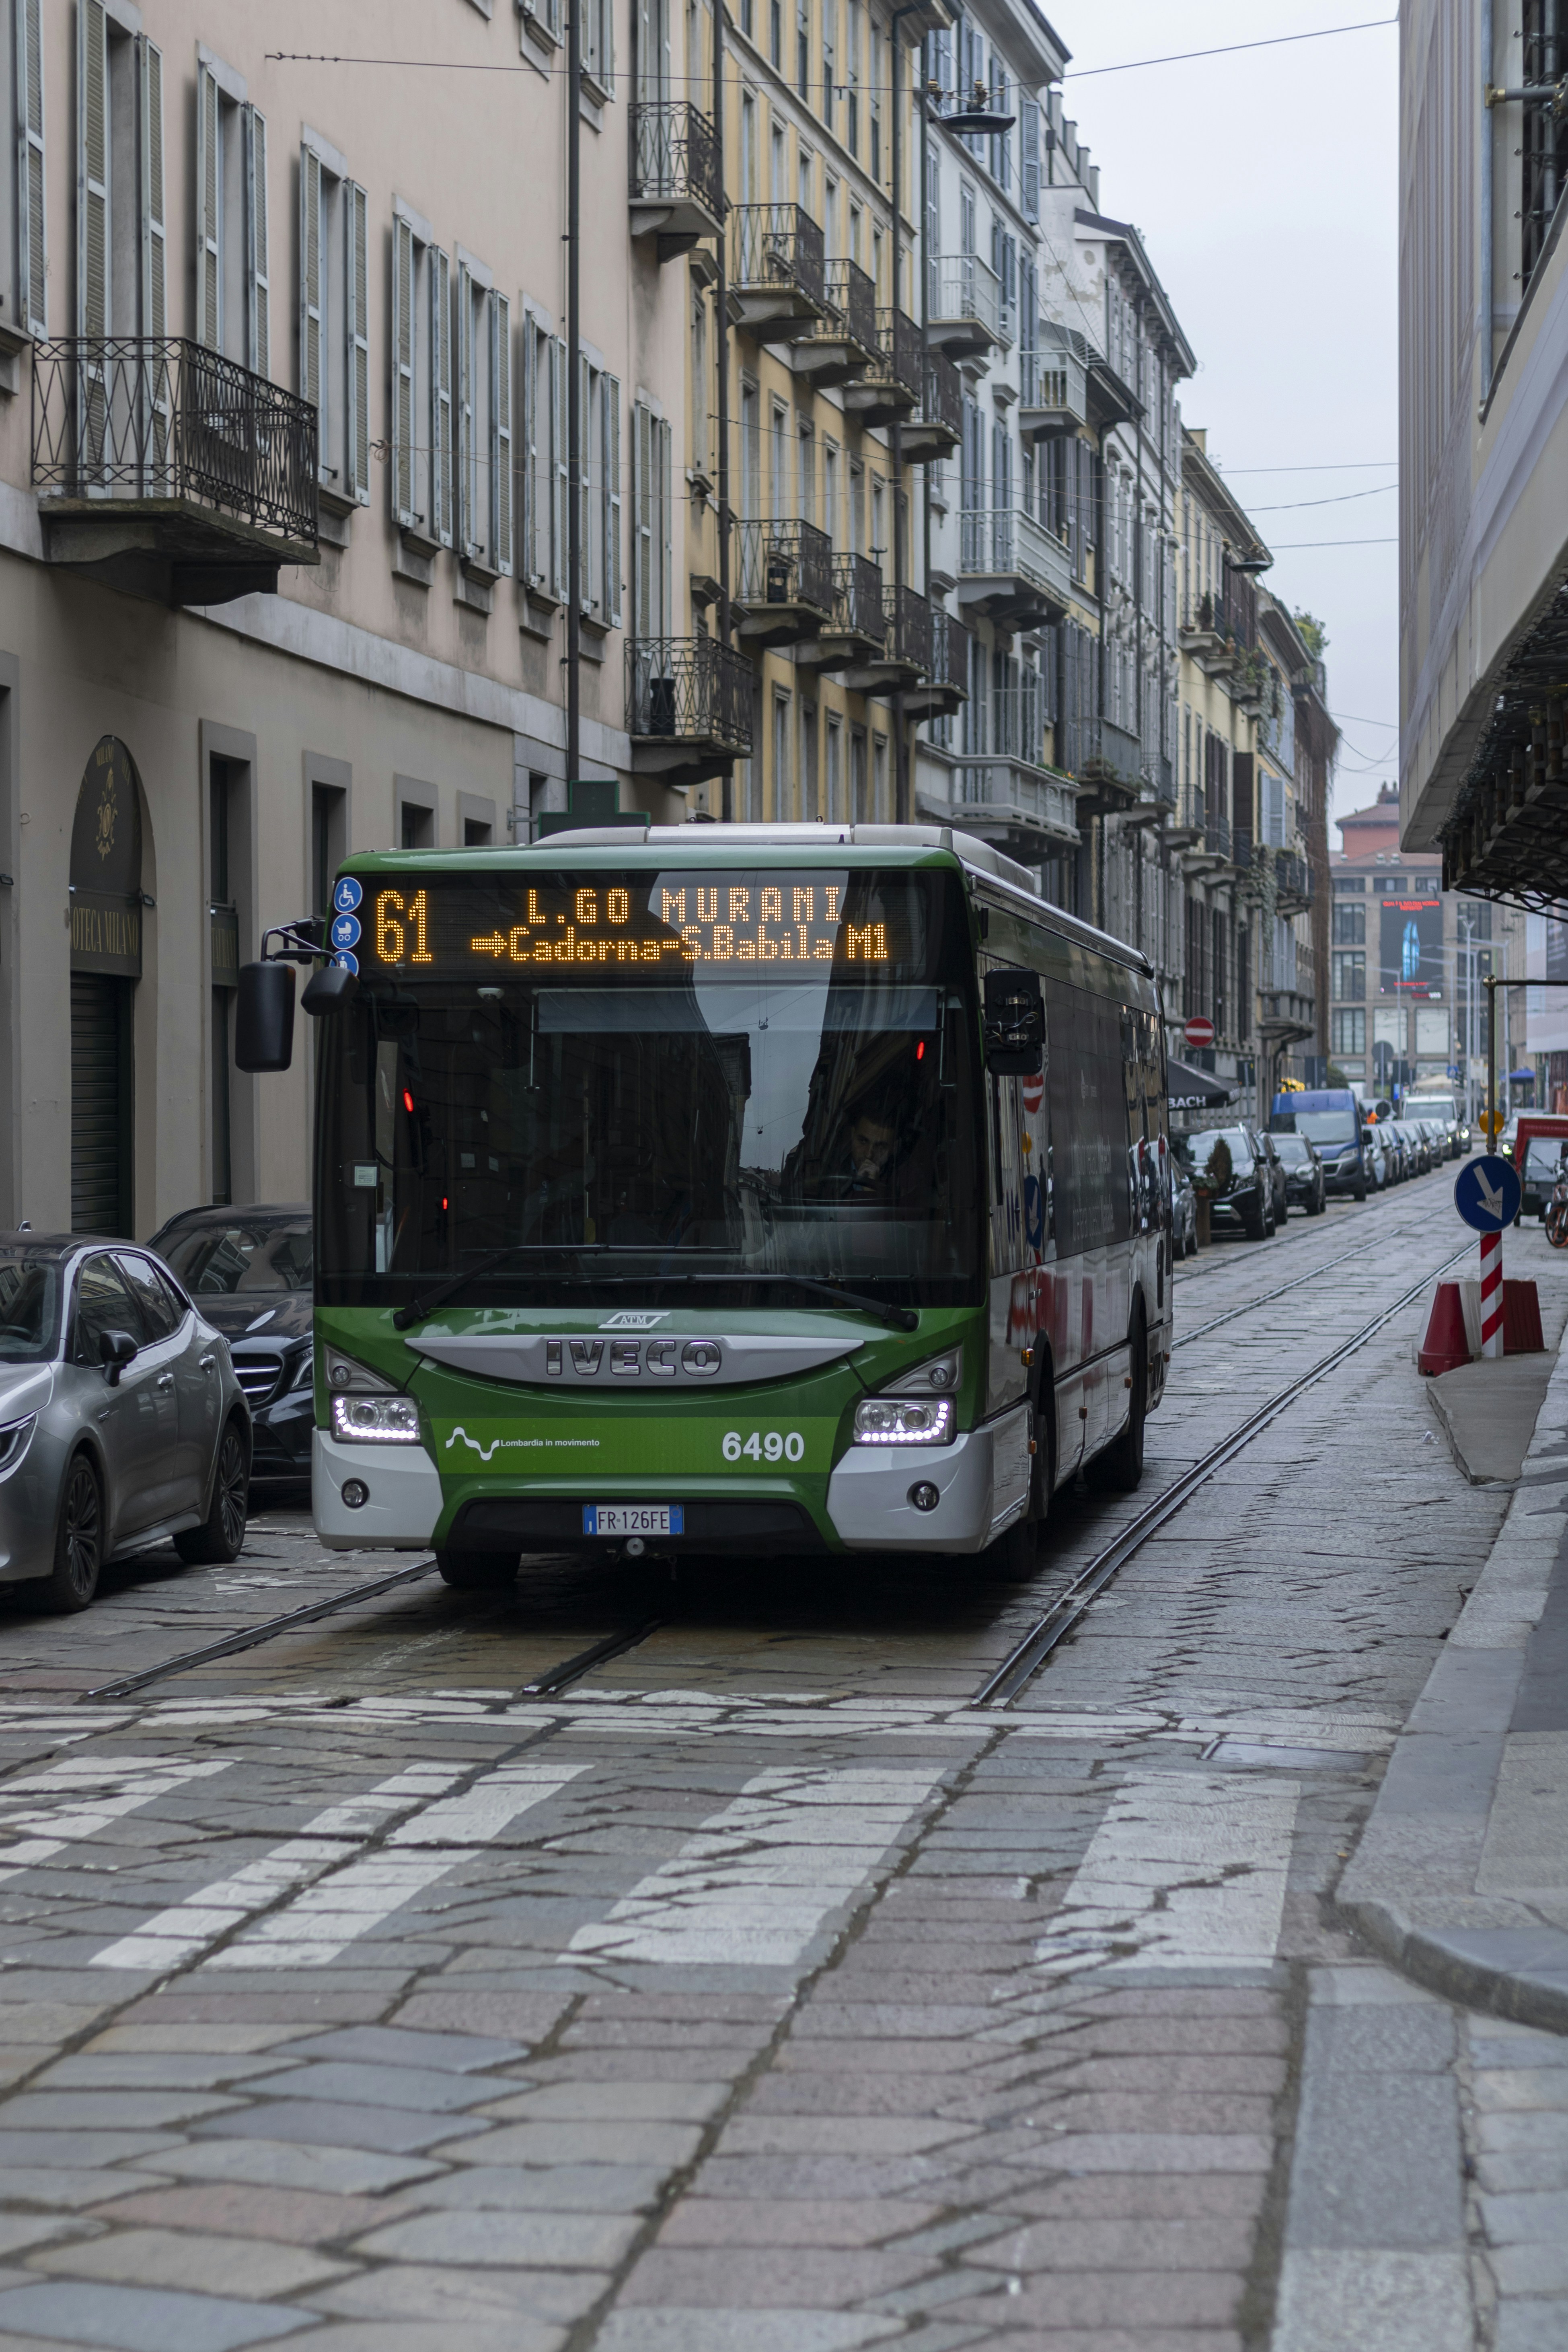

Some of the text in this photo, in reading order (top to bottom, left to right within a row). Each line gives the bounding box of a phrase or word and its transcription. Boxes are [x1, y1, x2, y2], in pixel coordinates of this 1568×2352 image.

[529, 887, 840, 923] L.GO MURANI
[70, 907, 138, 956] OTECA MILANO
[377, 890, 432, 962] 61
[848, 924, 888, 959] M1
[1168, 1096, 1206, 1109] BACH
[619, 1316, 647, 1324] ATM
[546, 1340, 722, 1377] IVECO
[722, 1432, 804, 1462] 6490
